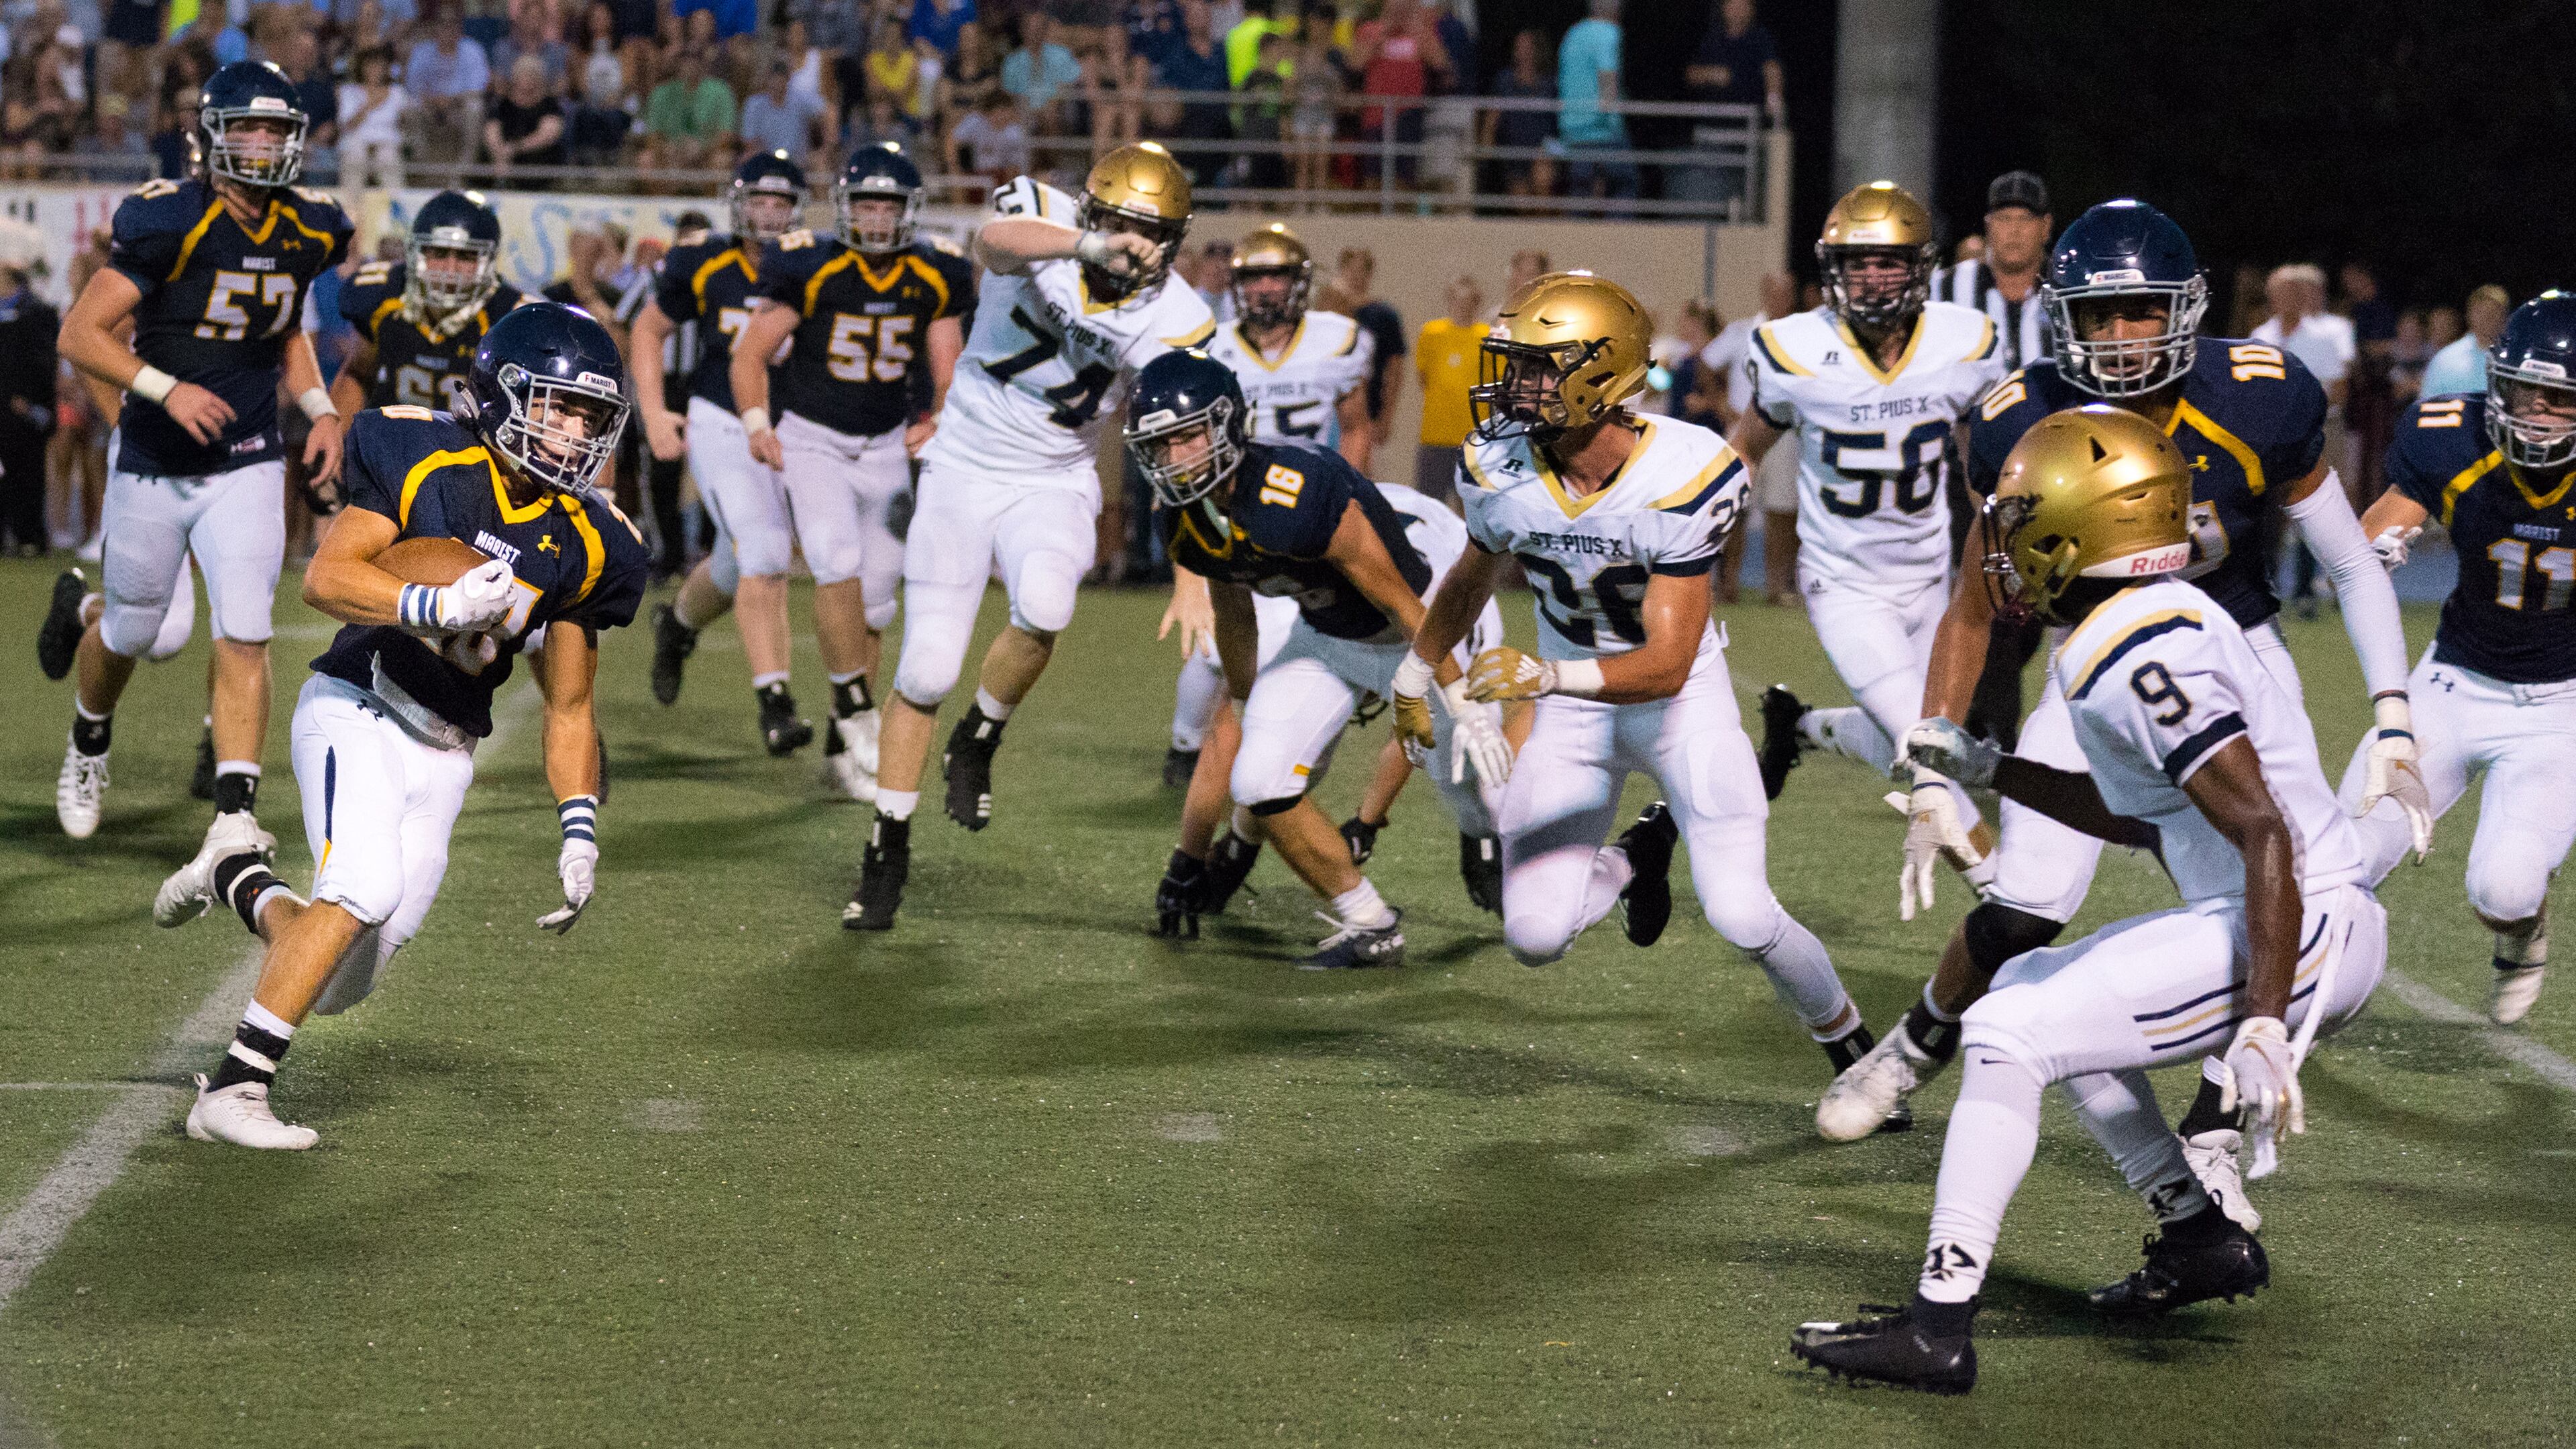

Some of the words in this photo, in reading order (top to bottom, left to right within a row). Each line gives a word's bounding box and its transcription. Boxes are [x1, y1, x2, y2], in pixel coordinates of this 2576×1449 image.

[194, 269, 298, 341] 57
[828, 312, 916, 382] 55
[2229, 344, 2286, 382] 10
[590, 377, 611, 388] MARIST
[1851, 405, 1876, 423] ST.
[1880, 398, 1912, 419] PIUS
[1258, 463, 1305, 509] 16
[474, 530, 521, 564] MARIST
[1561, 534, 1605, 554] PIUS
[2486, 538, 2576, 610] 11
[2130, 660, 2192, 726] 9
